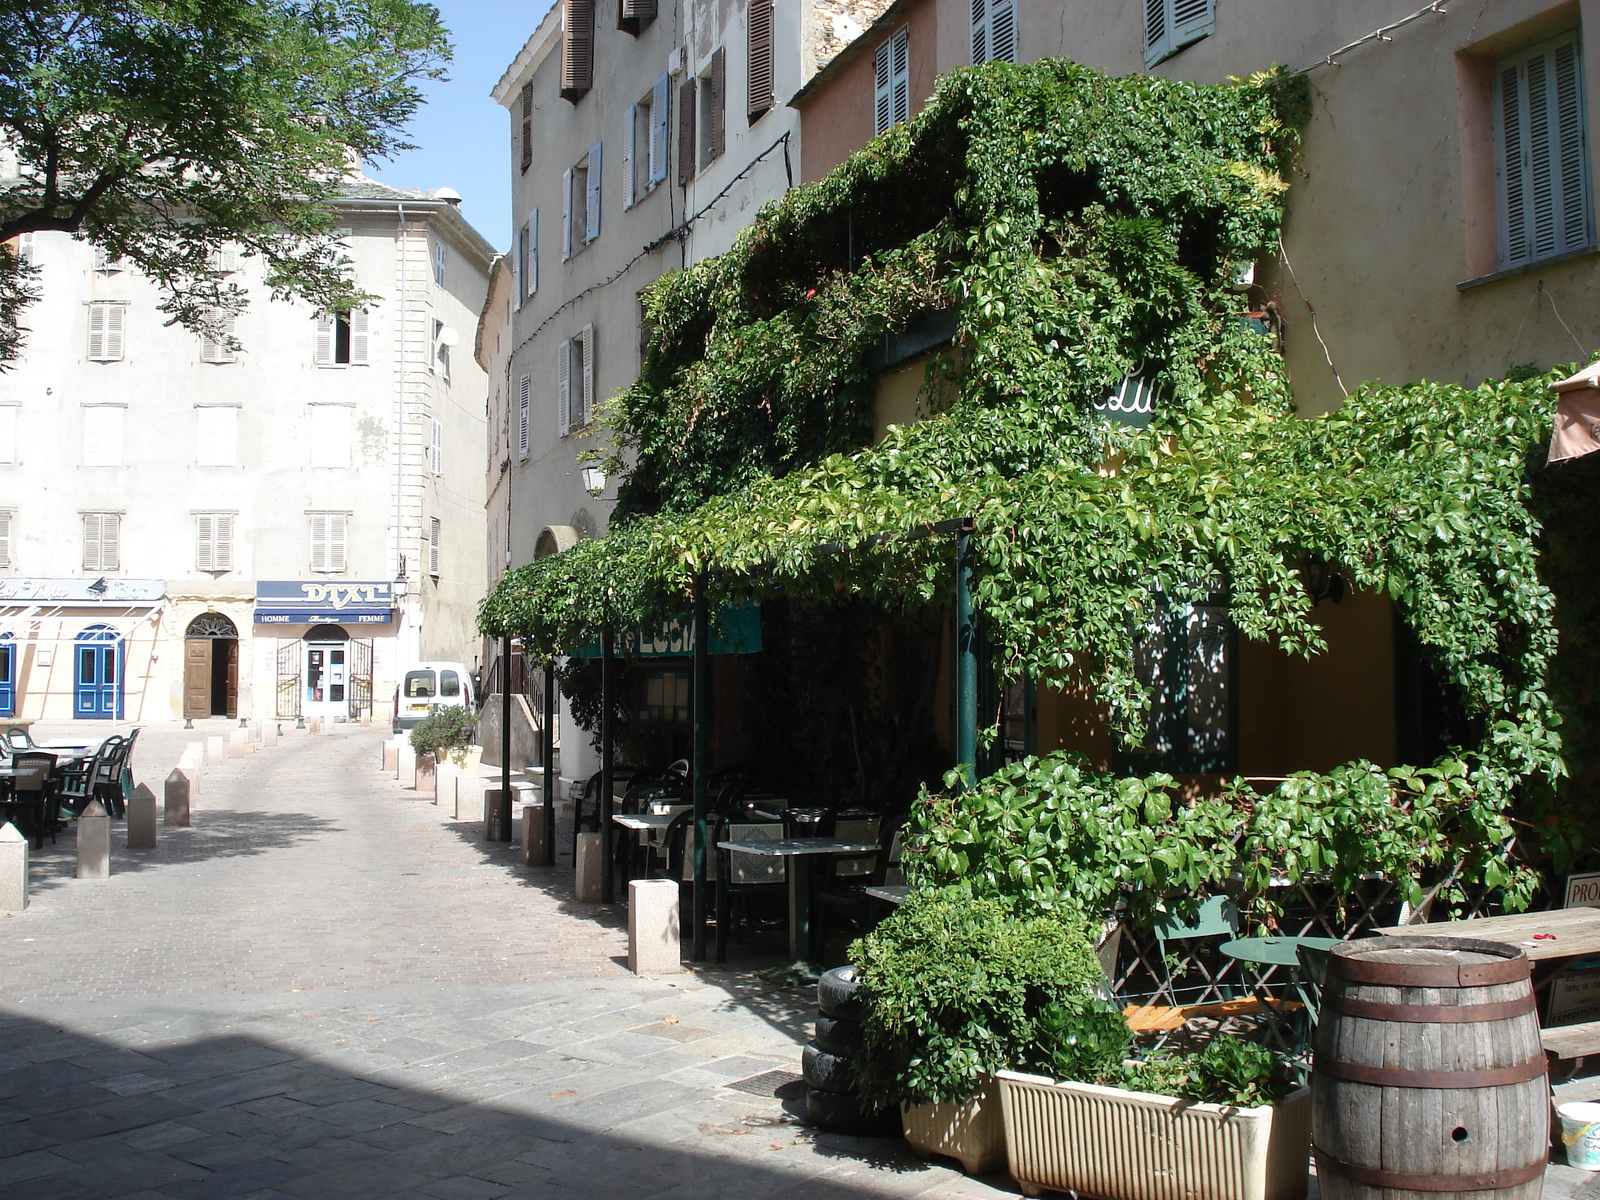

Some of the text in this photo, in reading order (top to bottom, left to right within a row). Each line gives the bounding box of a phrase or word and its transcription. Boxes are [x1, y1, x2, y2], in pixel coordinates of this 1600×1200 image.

[261, 615, 385, 624] HOMME Boutique FEMME
[1572, 882, 1600, 903] PRO
